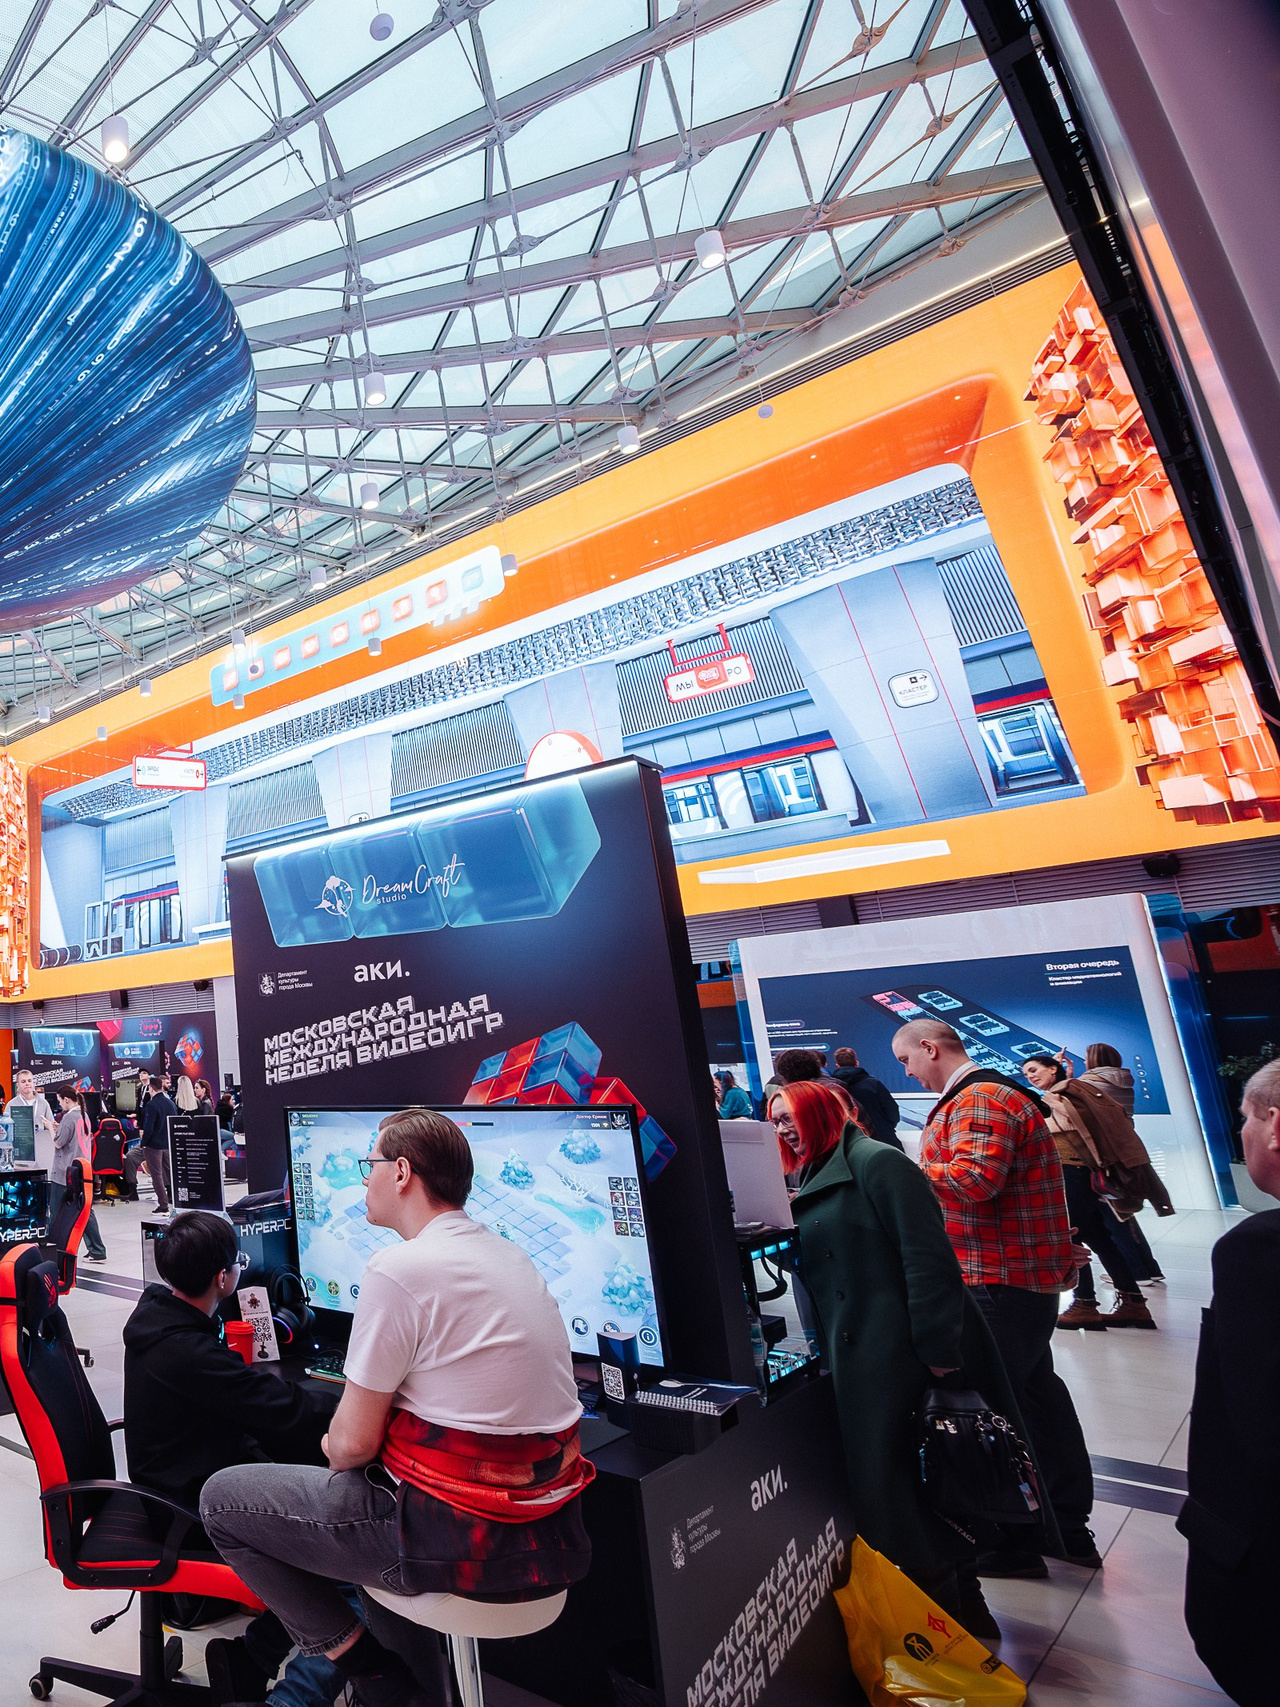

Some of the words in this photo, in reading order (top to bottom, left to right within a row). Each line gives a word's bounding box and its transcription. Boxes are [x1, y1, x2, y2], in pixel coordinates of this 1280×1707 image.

[376, 893, 406, 905] studio
[354, 959, 410, 983] аки.
[1045, 963, 1080, 971] Вторая
[1080, 960, 1120, 969] очередь
[264, 995, 416, 1052] МОСКОВСКАЯ
[264, 993, 491, 1069] МЕЖДУНАРОДНАЯ
[265, 1051, 352, 1085] НЕДЕЛЯ
[356, 1011, 504, 1066] ВИДЕОИГР
[240, 1218, 291, 1237] HYPERPC
[750, 1464, 788, 1512] аки.
[687, 1537, 798, 1707] МОСКОВСКАЯ
[767, 1539, 845, 1677] ВИДЕОИГР
